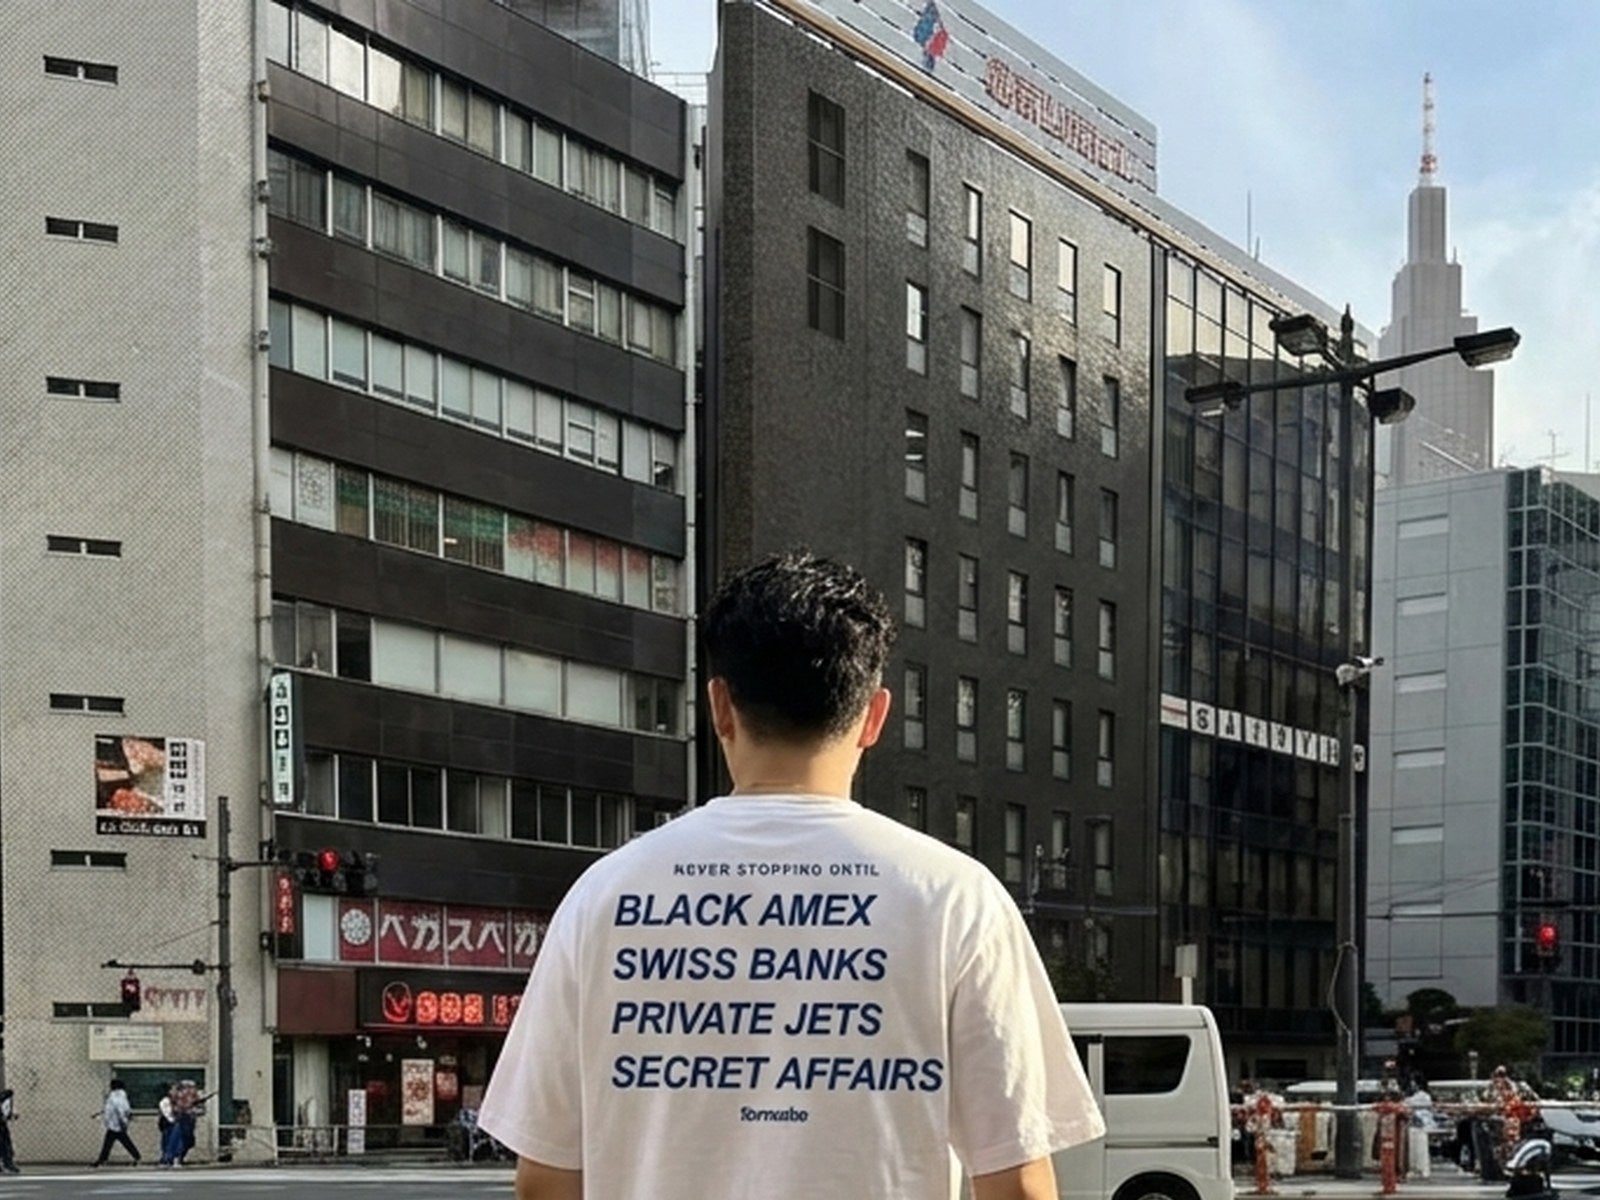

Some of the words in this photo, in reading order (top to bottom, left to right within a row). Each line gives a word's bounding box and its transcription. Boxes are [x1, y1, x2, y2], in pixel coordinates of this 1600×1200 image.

[613, 893, 753, 927] BLACK
[757, 893, 878, 927] AMEX
[612, 947, 739, 982] SWISS
[748, 947, 888, 982] BANKS
[611, 1001, 776, 1036] PRIVATE
[783, 1001, 883, 1037] JETS
[611, 1055, 771, 1090] SECRET
[775, 1055, 944, 1093] AFFAIRS
